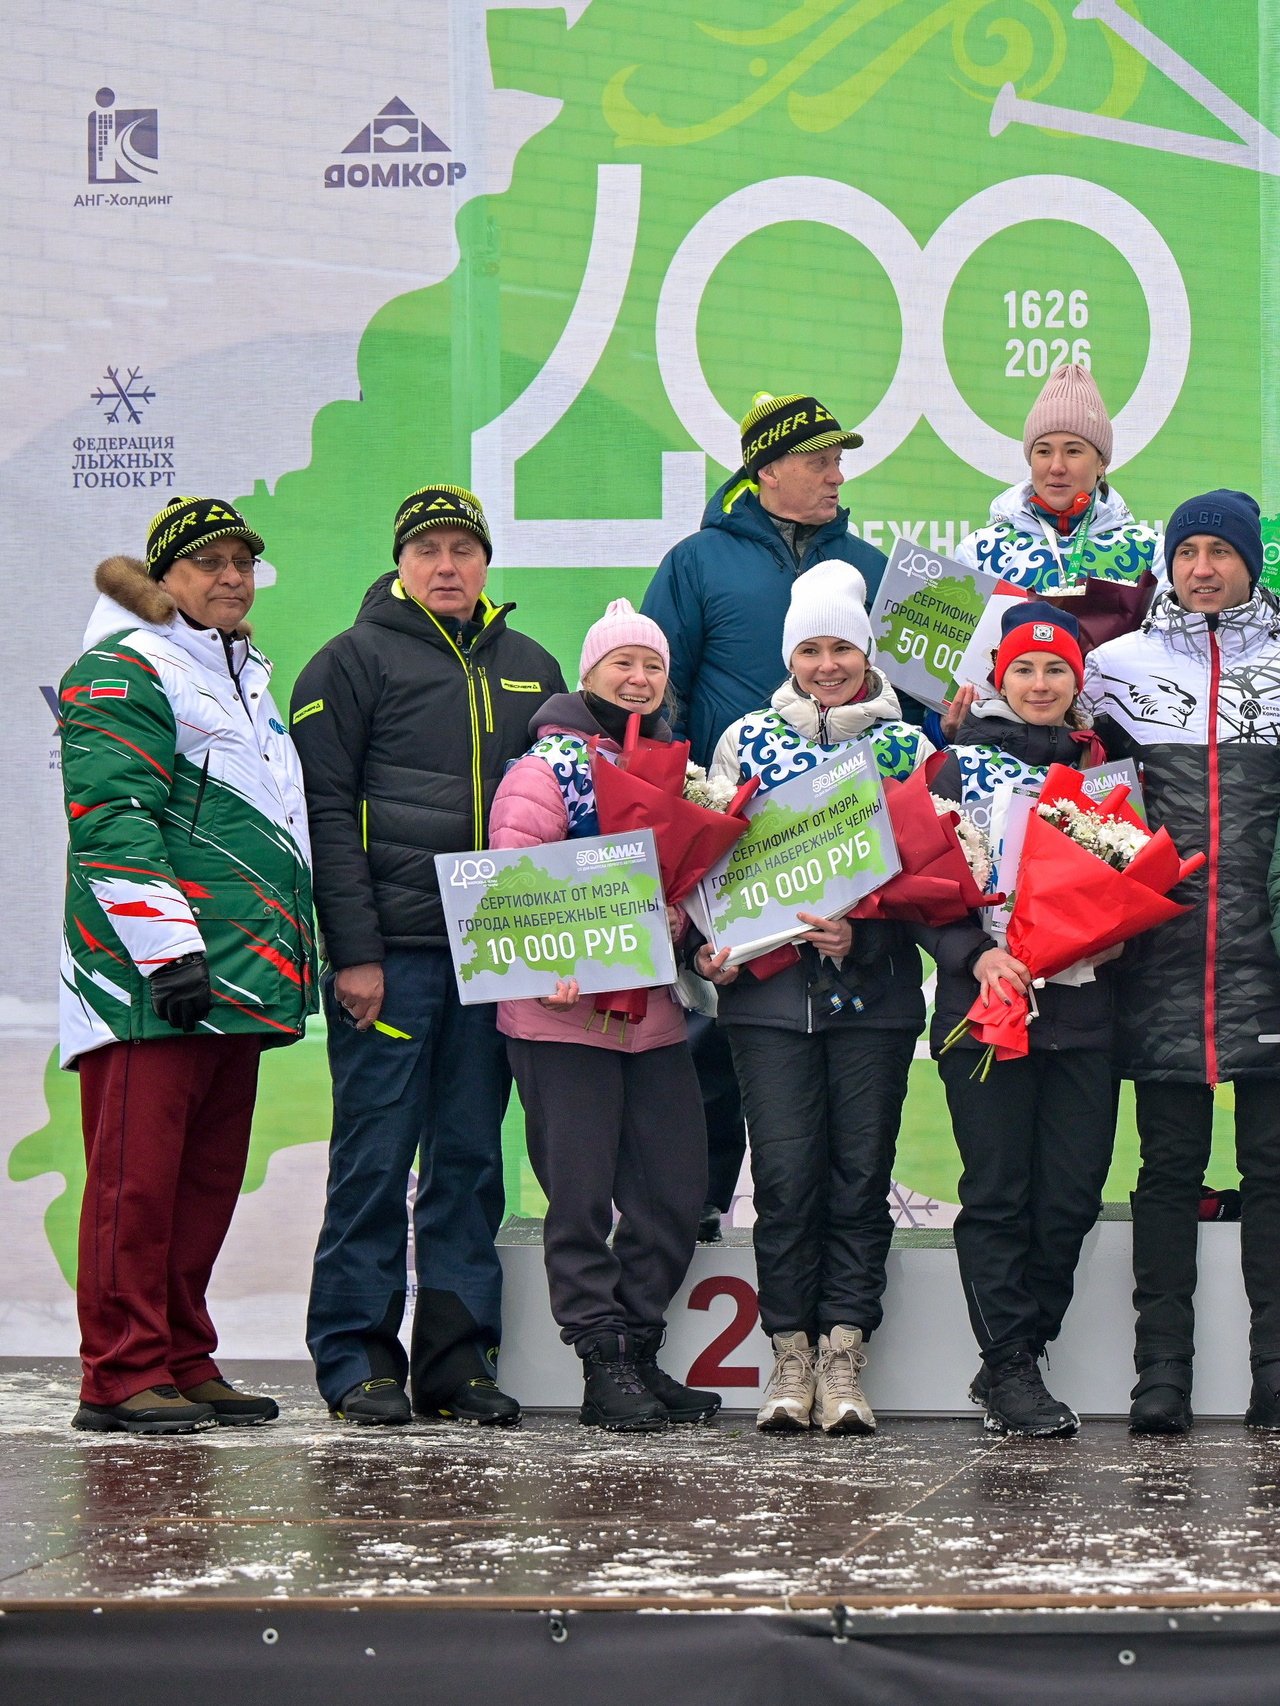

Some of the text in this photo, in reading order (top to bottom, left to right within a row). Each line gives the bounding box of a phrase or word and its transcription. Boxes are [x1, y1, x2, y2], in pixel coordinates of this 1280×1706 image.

[324, 162, 467, 189] ДОМКОР
[73, 193, 173, 208] АНГ-Холдинг
[1004, 289, 1089, 329] 1626
[1005, 338, 1092, 378] 2026
[71, 452, 174, 470] ЛЫЖНЫХ
[72, 436, 175, 453] ФЕДЕРАЦИЯ
[72, 471, 176, 488] ГОНОК РТ
[1176, 511, 1222, 530] ALGA
[884, 598, 973, 644] ГОРОДА НАБЕР
[913, 591, 979, 628] СЕРТИФИК
[896, 626, 965, 675] 50 00
[829, 750, 866, 782] KAMAZ
[1093, 770, 1131, 791] KAMAZ
[711, 798, 883, 889] ГОРОДА НАБЕРЕЖНЫЕ ЧЕЛНЫ
[732, 793, 859, 863] СЕРТИФИКАТ ОТ МЭРА
[598, 841, 645, 861] KAMAZ
[739, 830, 871, 911] 10 000 РУБ
[480, 881, 630, 910] СЕРТИФИКАТ ОТ МЭРА
[457, 897, 660, 933] ГОРОДА НАБЕРЕЖНЫЕ ЧЕЛНЫ
[486, 923, 638, 965] 10 000 РУБ
[686, 1276, 760, 1388] 2
